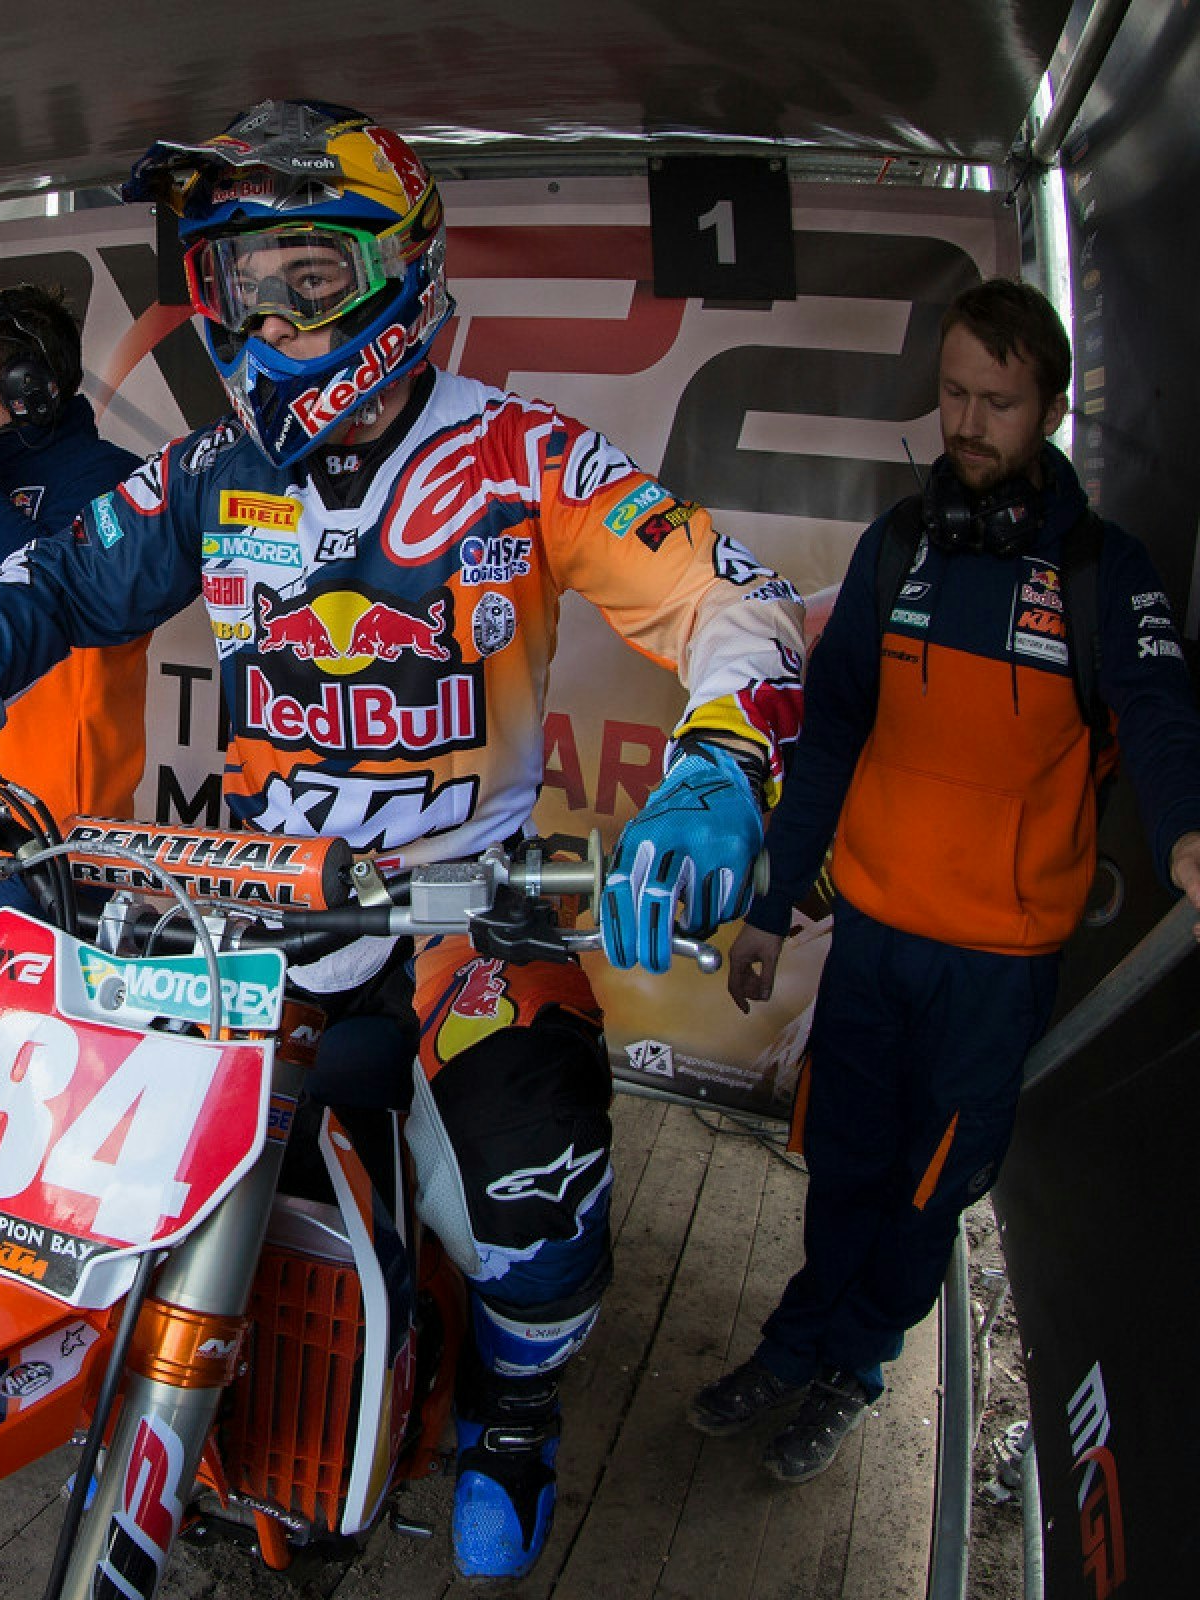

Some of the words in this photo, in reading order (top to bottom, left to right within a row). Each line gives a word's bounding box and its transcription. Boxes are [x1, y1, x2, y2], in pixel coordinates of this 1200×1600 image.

[699, 200, 737, 264] 1
[289, 342, 385, 438] Red
[326, 456, 360, 475] 84
[484, 538, 531, 566] HSF
[246, 666, 347, 750] Red
[349, 675, 475, 750] Bull
[251, 770, 479, 849] KTM
[65, 824, 310, 874] RENTHAL
[71, 861, 312, 908] RENTHAL
[126, 963, 280, 1017] MOTOREX
[49, 1236, 95, 1262] BAY
